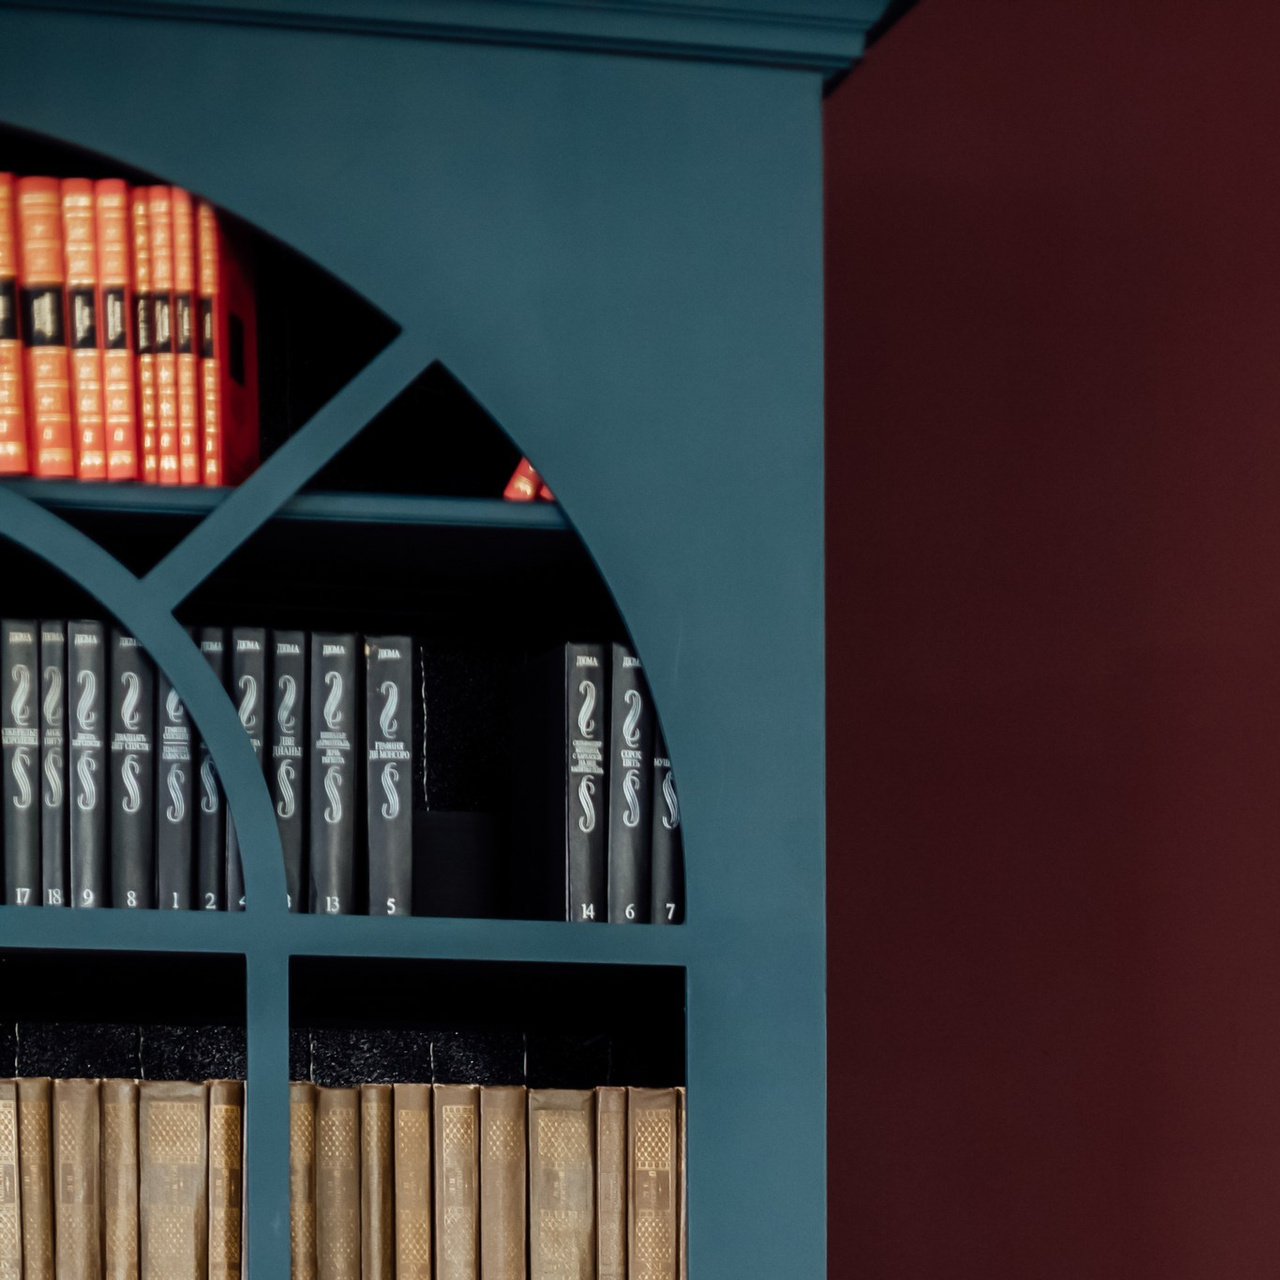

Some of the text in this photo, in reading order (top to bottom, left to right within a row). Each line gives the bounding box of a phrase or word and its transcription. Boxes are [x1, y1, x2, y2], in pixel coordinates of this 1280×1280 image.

[15, 887, 31, 905] 17
[47, 888, 62, 905] 18
[82, 888, 94, 907] 9
[126, 891, 137, 908] 8
[172, 892, 179, 909] 1
[204, 892, 216, 909] 2
[326, 896, 340, 913] 13
[386, 898, 396, 915] 5
[581, 903, 595, 919] 14
[625, 903, 635, 919] 6
[666, 903, 676, 920] 7
